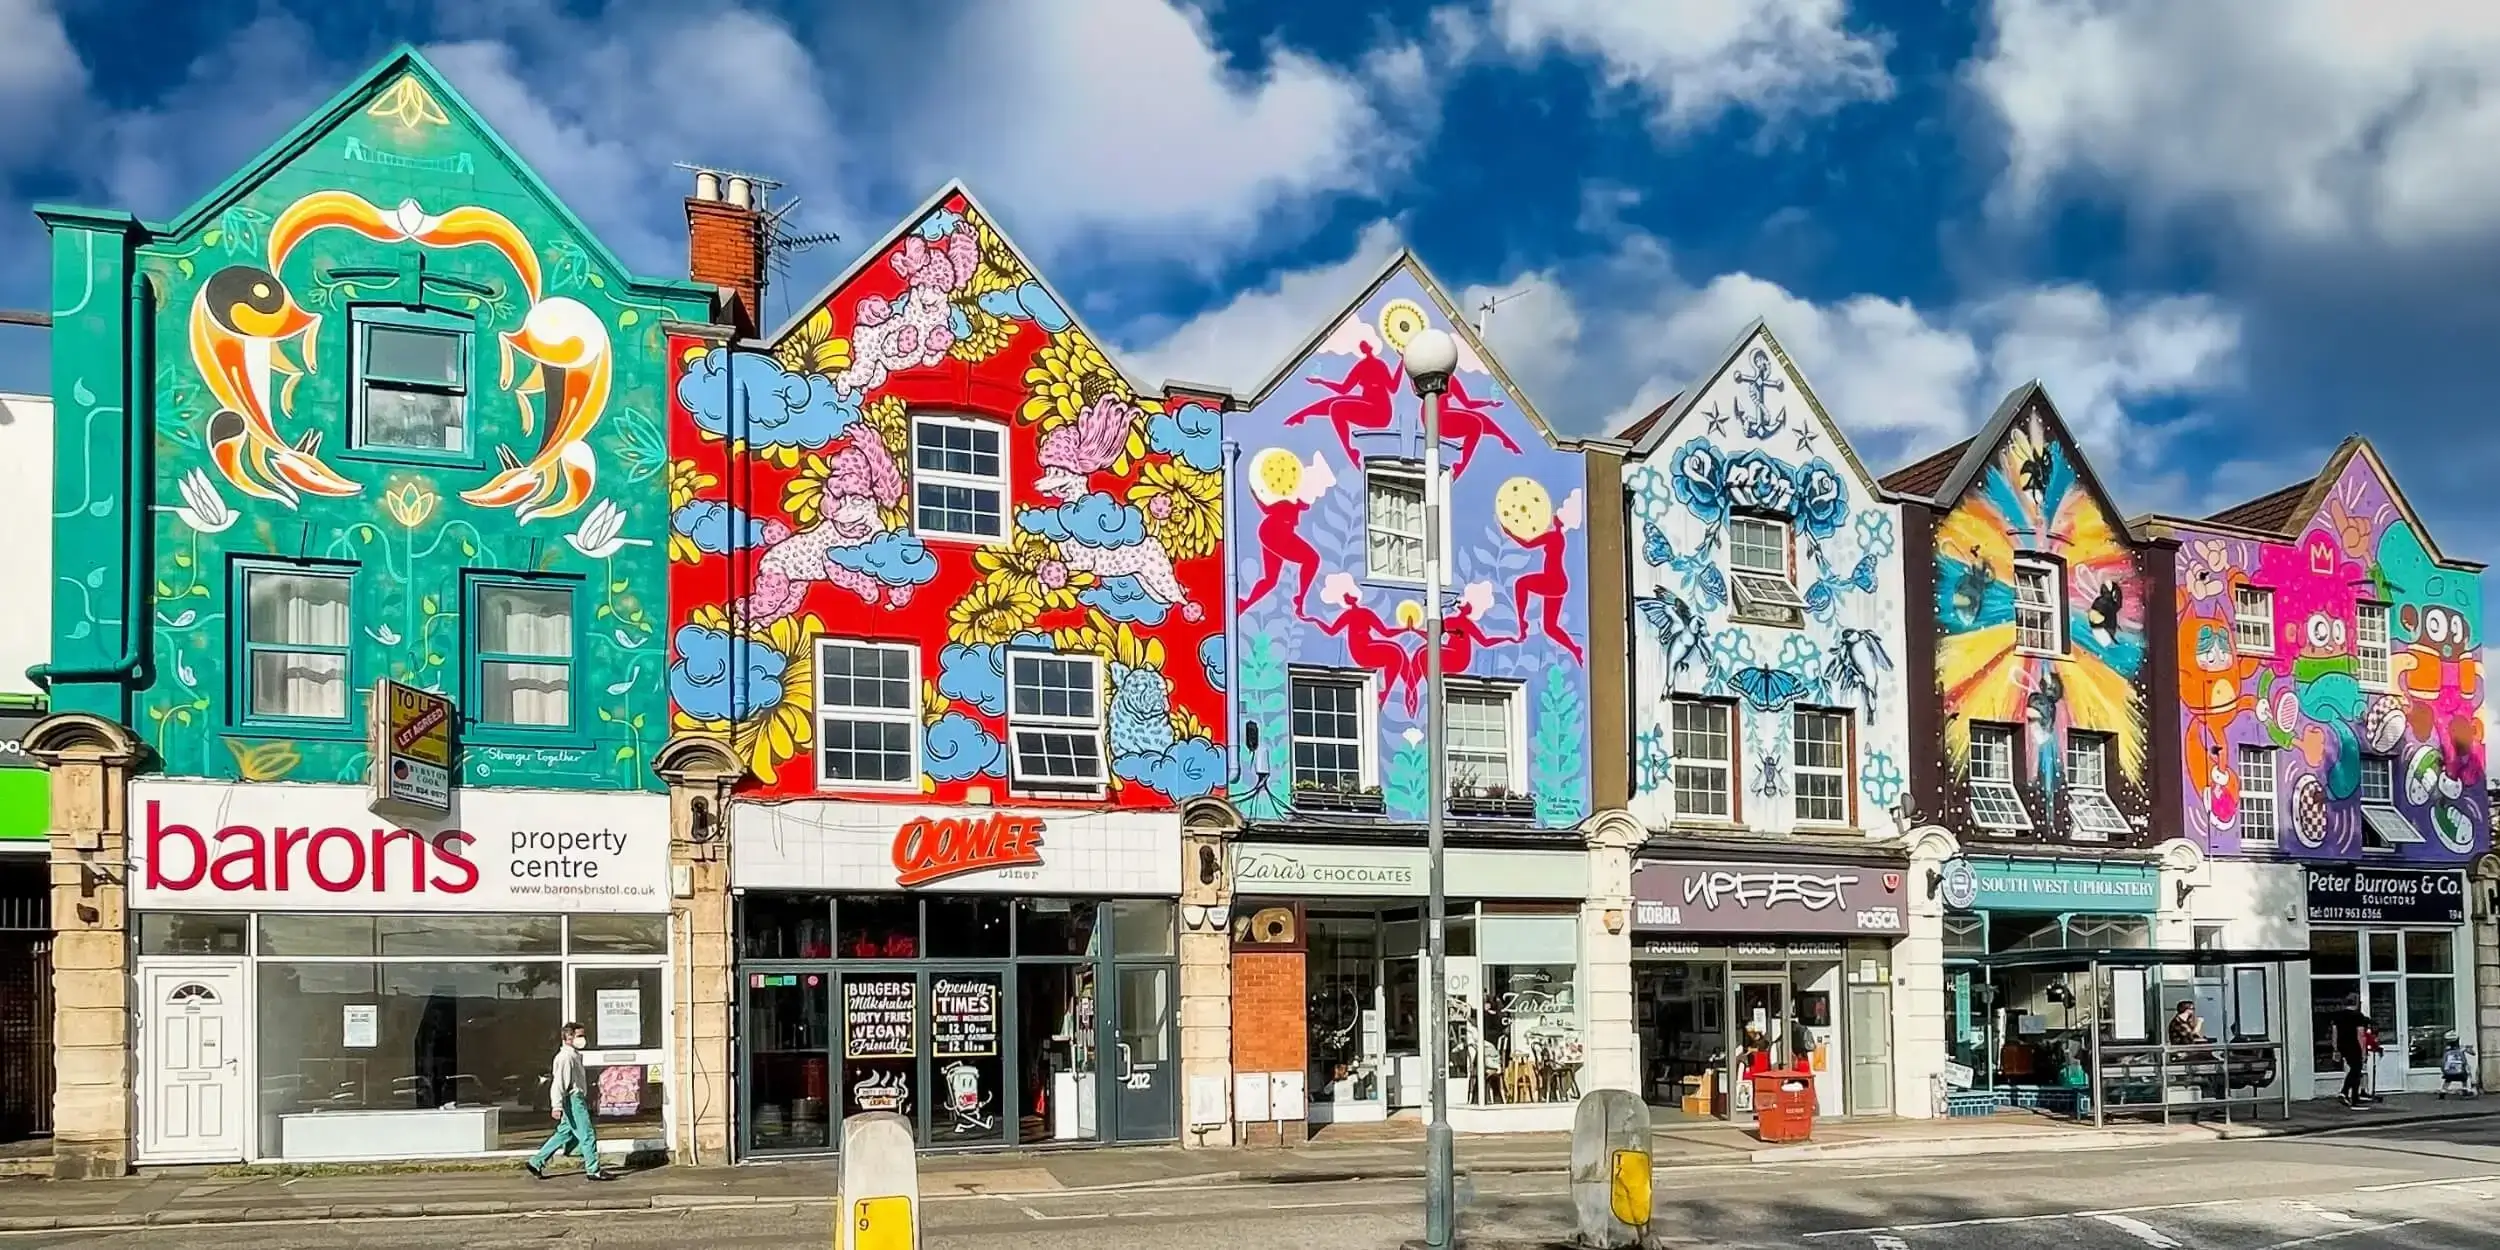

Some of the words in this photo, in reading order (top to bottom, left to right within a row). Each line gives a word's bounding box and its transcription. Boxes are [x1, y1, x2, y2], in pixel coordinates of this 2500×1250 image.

[396, 688, 415, 709] TO
[398, 729, 412, 747] LET
[413, 708, 444, 735] AGREED
[146, 799, 479, 894] barons
[510, 828, 627, 856] property
[892, 813, 1046, 874] OOWEE
[510, 856, 598, 878] centre
[998, 868, 1039, 880] Diner
[1239, 853, 1305, 879] Zara's
[1313, 868, 1412, 882] CHOCOLATES
[510, 883, 655, 897] www.baronsbristol.co.uk
[1683, 871, 1859, 911] UPFEST
[1981, 877, 2028, 893] SOUTH
[2032, 879, 2069, 895] WEST
[2073, 879, 2155, 897] UPHOLSTERY
[2308, 872, 2351, 891] Peter
[2355, 873, 2417, 894] Burrows
[2420, 875, 2435, 894] &
[2437, 876, 2461, 895] Co.
[2362, 895, 2416, 905] SOLICITORS
[1638, 906, 1681, 924] KOBRA
[1857, 911, 1900, 928] POSCA
[2323, 908, 2343, 918] 0117
[2345, 908, 2360, 919] 963
[1645, 941, 1699, 954] FRAMING
[849, 983, 911, 996] BURGERS
[935, 979, 989, 997] Opening
[938, 997, 989, 1013] TIMES
[850, 1012, 881, 1024] DIRTY
[884, 1012, 912, 1024] FRIES
[855, 1025, 907, 1039] VEGAN
[949, 1023, 960, 1034] 12
[850, 1038, 913, 1056] Friendly
[949, 1041, 960, 1052] 12
[1127, 1073, 1151, 1089] 202
[860, 1203, 870, 1215] T
[859, 1218, 869, 1231] 9
